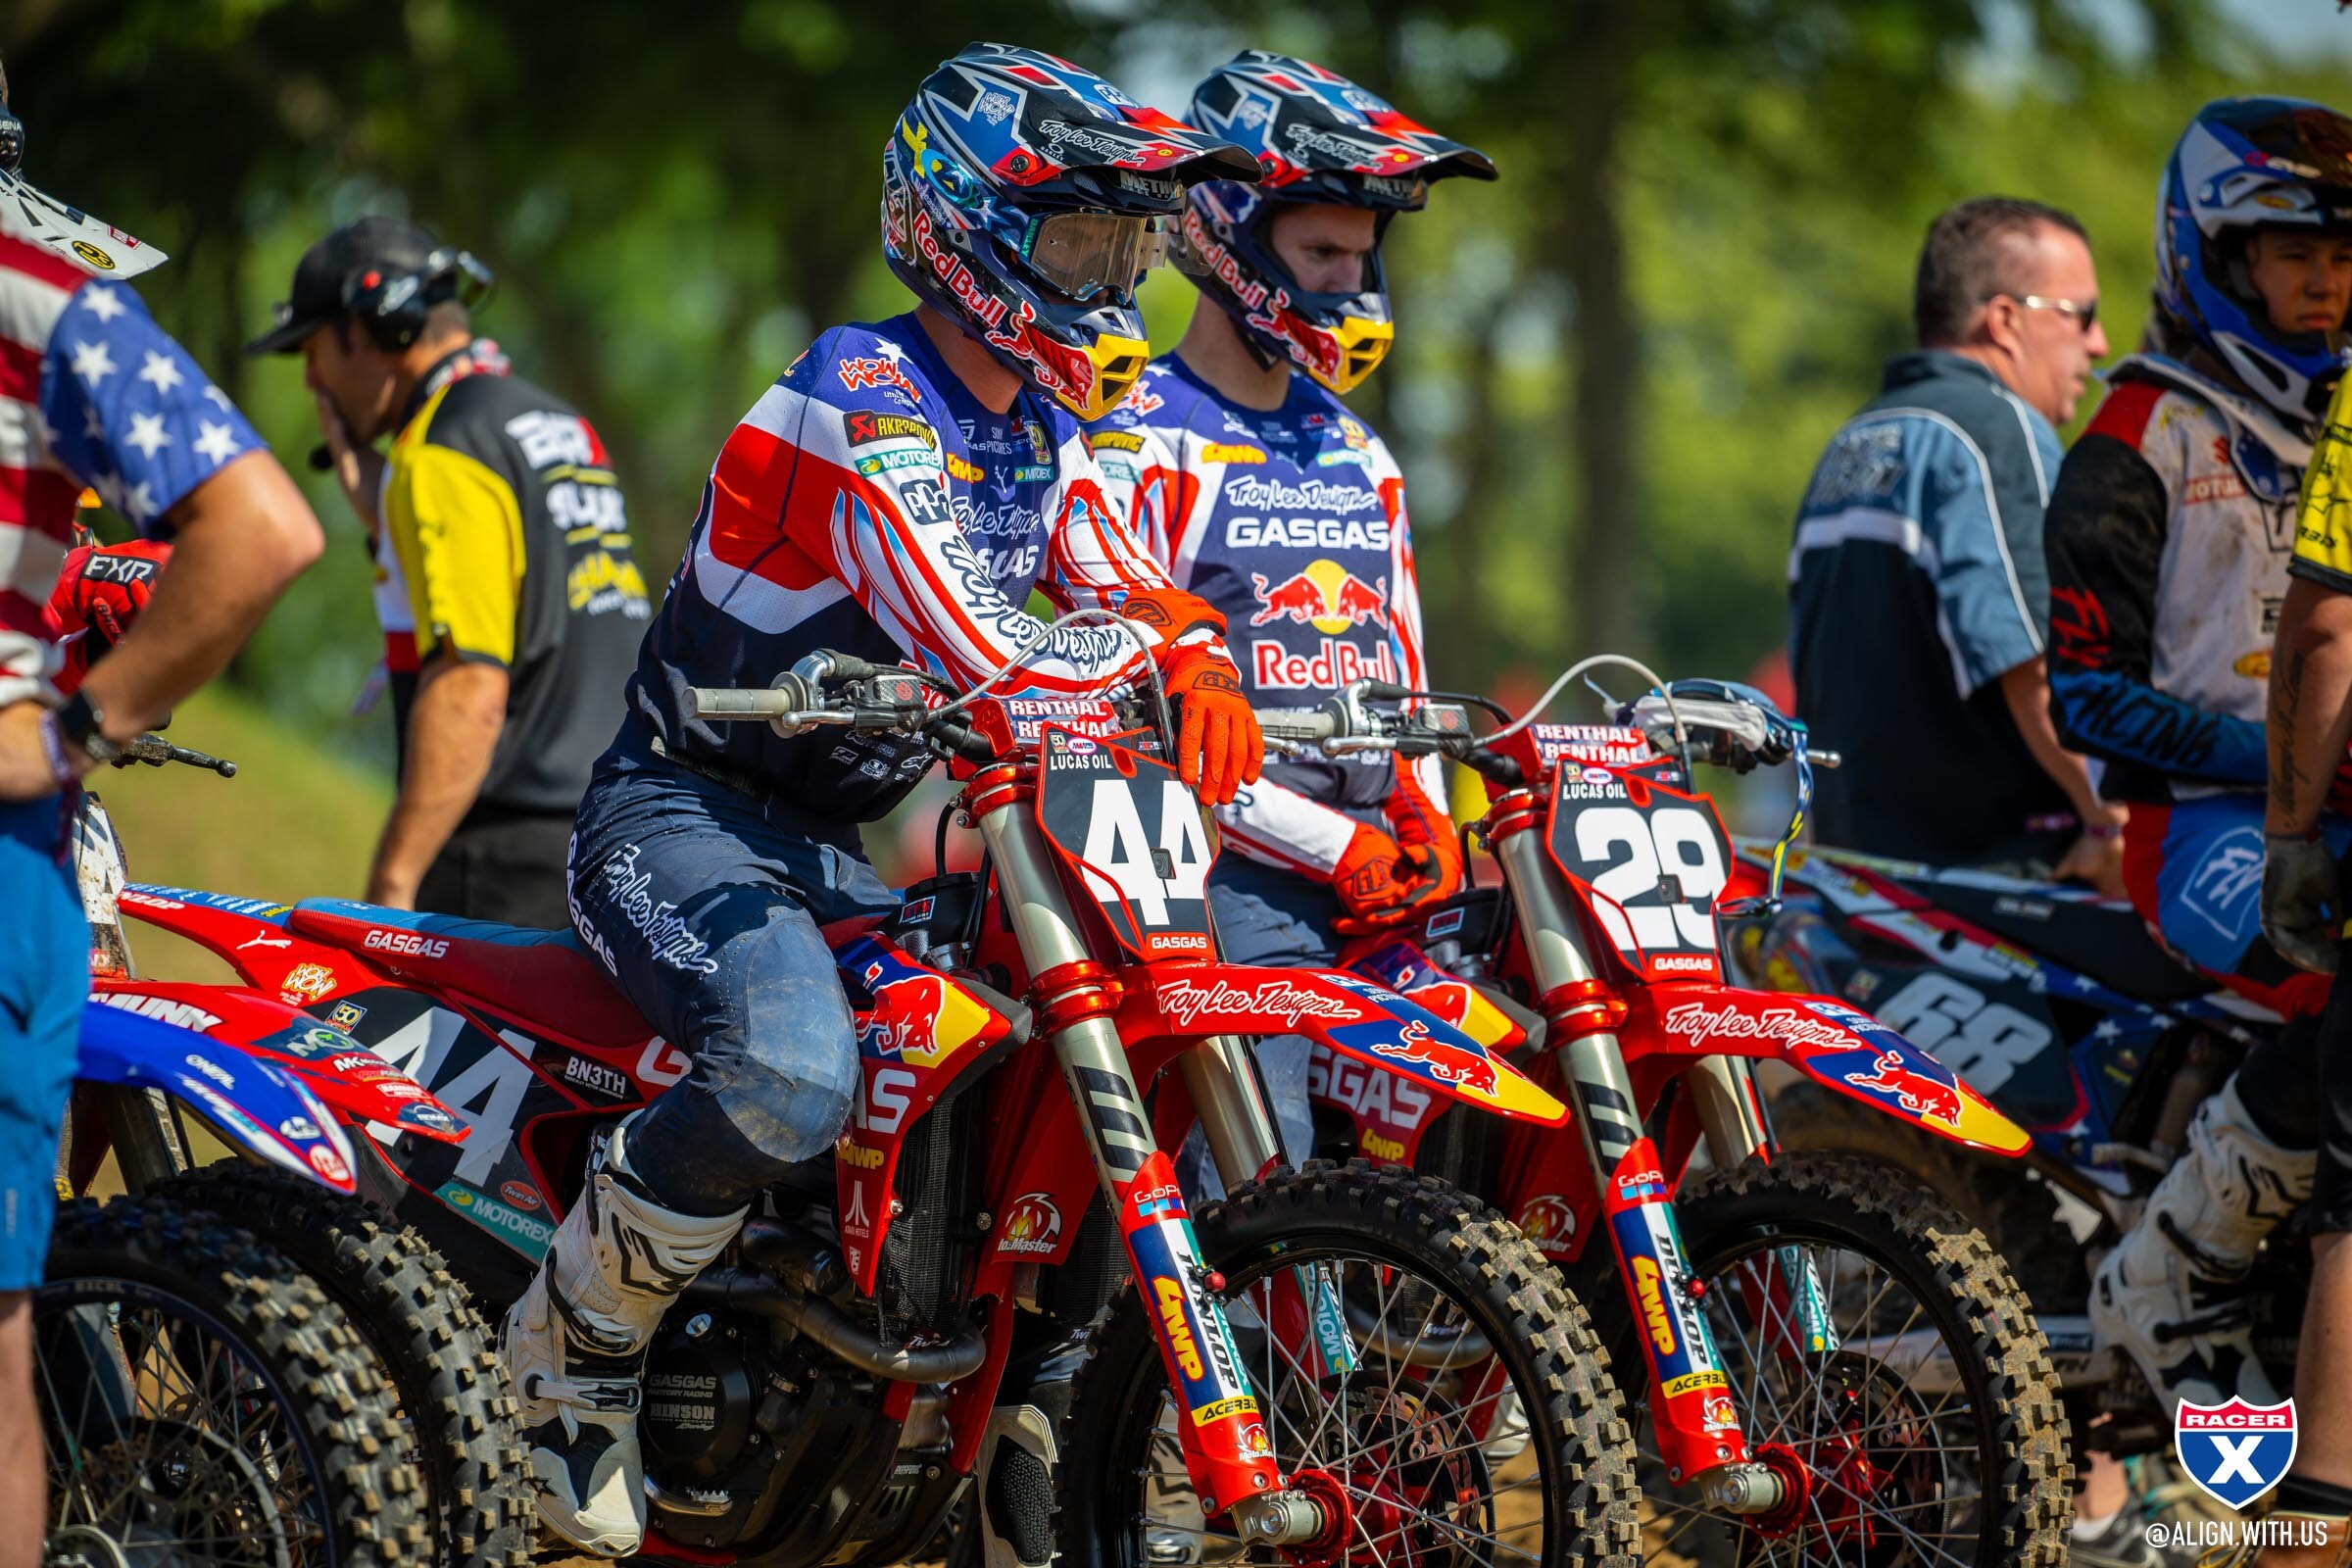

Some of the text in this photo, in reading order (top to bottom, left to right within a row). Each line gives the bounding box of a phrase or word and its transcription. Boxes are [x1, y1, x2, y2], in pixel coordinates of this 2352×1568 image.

[1038, 119, 1147, 167] Troy Lee Designs
[913, 208, 961, 281] Red
[947, 263, 1008, 329] Bull
[1184, 208, 1269, 311] Red Bull
[1225, 516, 1392, 551] GASGAS
[84, 555, 154, 583] FXR
[1251, 638, 1335, 690] Red
[1336, 639, 1398, 688] Bull
[1008, 699, 1107, 716] RENTHAL
[1536, 724, 1638, 744] RENTHAL
[1050, 754, 1112, 771] LUCAS OIL
[1563, 783, 1627, 800] LUCAS OIL
[1080, 778, 1212, 926] 44
[1574, 807, 1728, 951] 29
[364, 929, 450, 957] GASGAS
[1151, 935, 1207, 951] GASGAS
[1654, 956, 1714, 971] GASGAS
[334, 1003, 361, 1025] 50
[1155, 978, 1362, 1028] Troy Lee Designs
[1665, 1002, 1862, 1051] Troy Lee Designs
[1874, 970, 2053, 1097] 68
[565, 1055, 626, 1095] BN3TH
[504, 1186, 538, 1206] Twin Air
[472, 1198, 554, 1244] MOTOREX
[1630, 1255, 1677, 1356] 4WP
[1151, 1274, 1205, 1383] 4WP
[650, 1374, 717, 1390] GASGAS
[650, 1402, 715, 1421] HINSON
